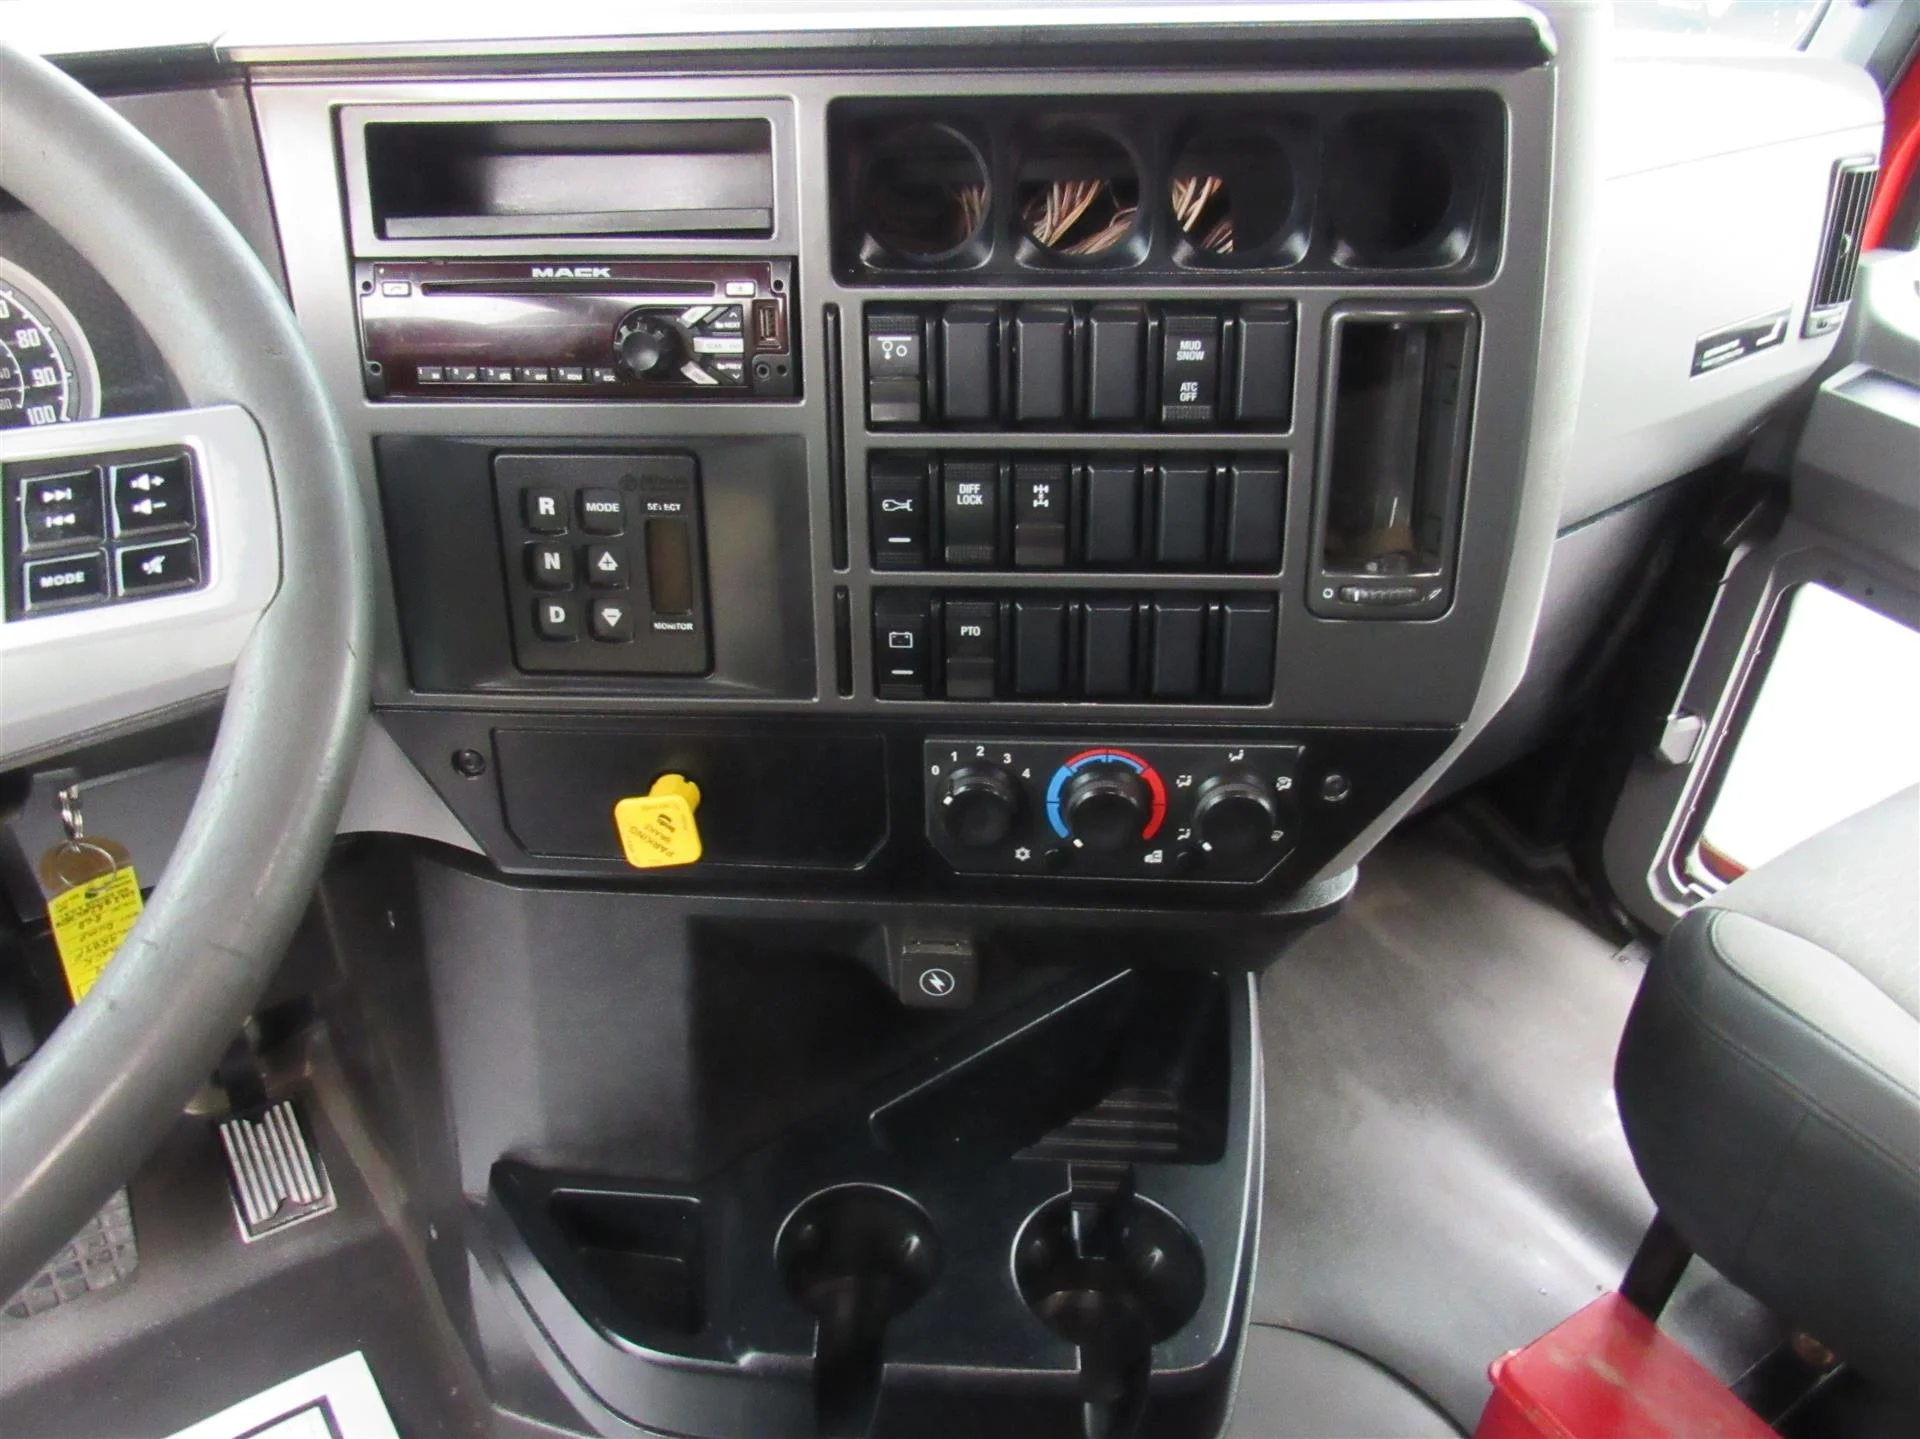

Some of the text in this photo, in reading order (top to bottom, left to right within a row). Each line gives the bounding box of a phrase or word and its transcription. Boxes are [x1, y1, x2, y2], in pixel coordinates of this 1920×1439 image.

[531, 267, 611, 278] MACK
[16, 328, 41, 348] 80
[1180, 341, 1201, 351] MUD
[1176, 351, 1204, 361] SNOW
[32, 367, 57, 387] 90
[1180, 382, 1198, 392] ATC
[1180, 392, 1198, 402] OFF
[27, 405, 56, 425] 100
[959, 484, 980, 494] DIFF
[957, 495, 983, 505] LOCK
[538, 497, 556, 515] R
[586, 503, 620, 512] MODE
[647, 502, 681, 512] SELECT
[543, 552, 561, 570] N
[40, 571, 85, 587] MODE
[549, 605, 566, 623] D
[654, 622, 694, 631] MONITOR
[960, 626, 980, 636] PTO
[950, 751, 958, 762] 1
[976, 745, 985, 757] 2
[1003, 753, 1012, 764] 3
[931, 765, 940, 776] 0
[1021, 768, 1030, 778] 4
